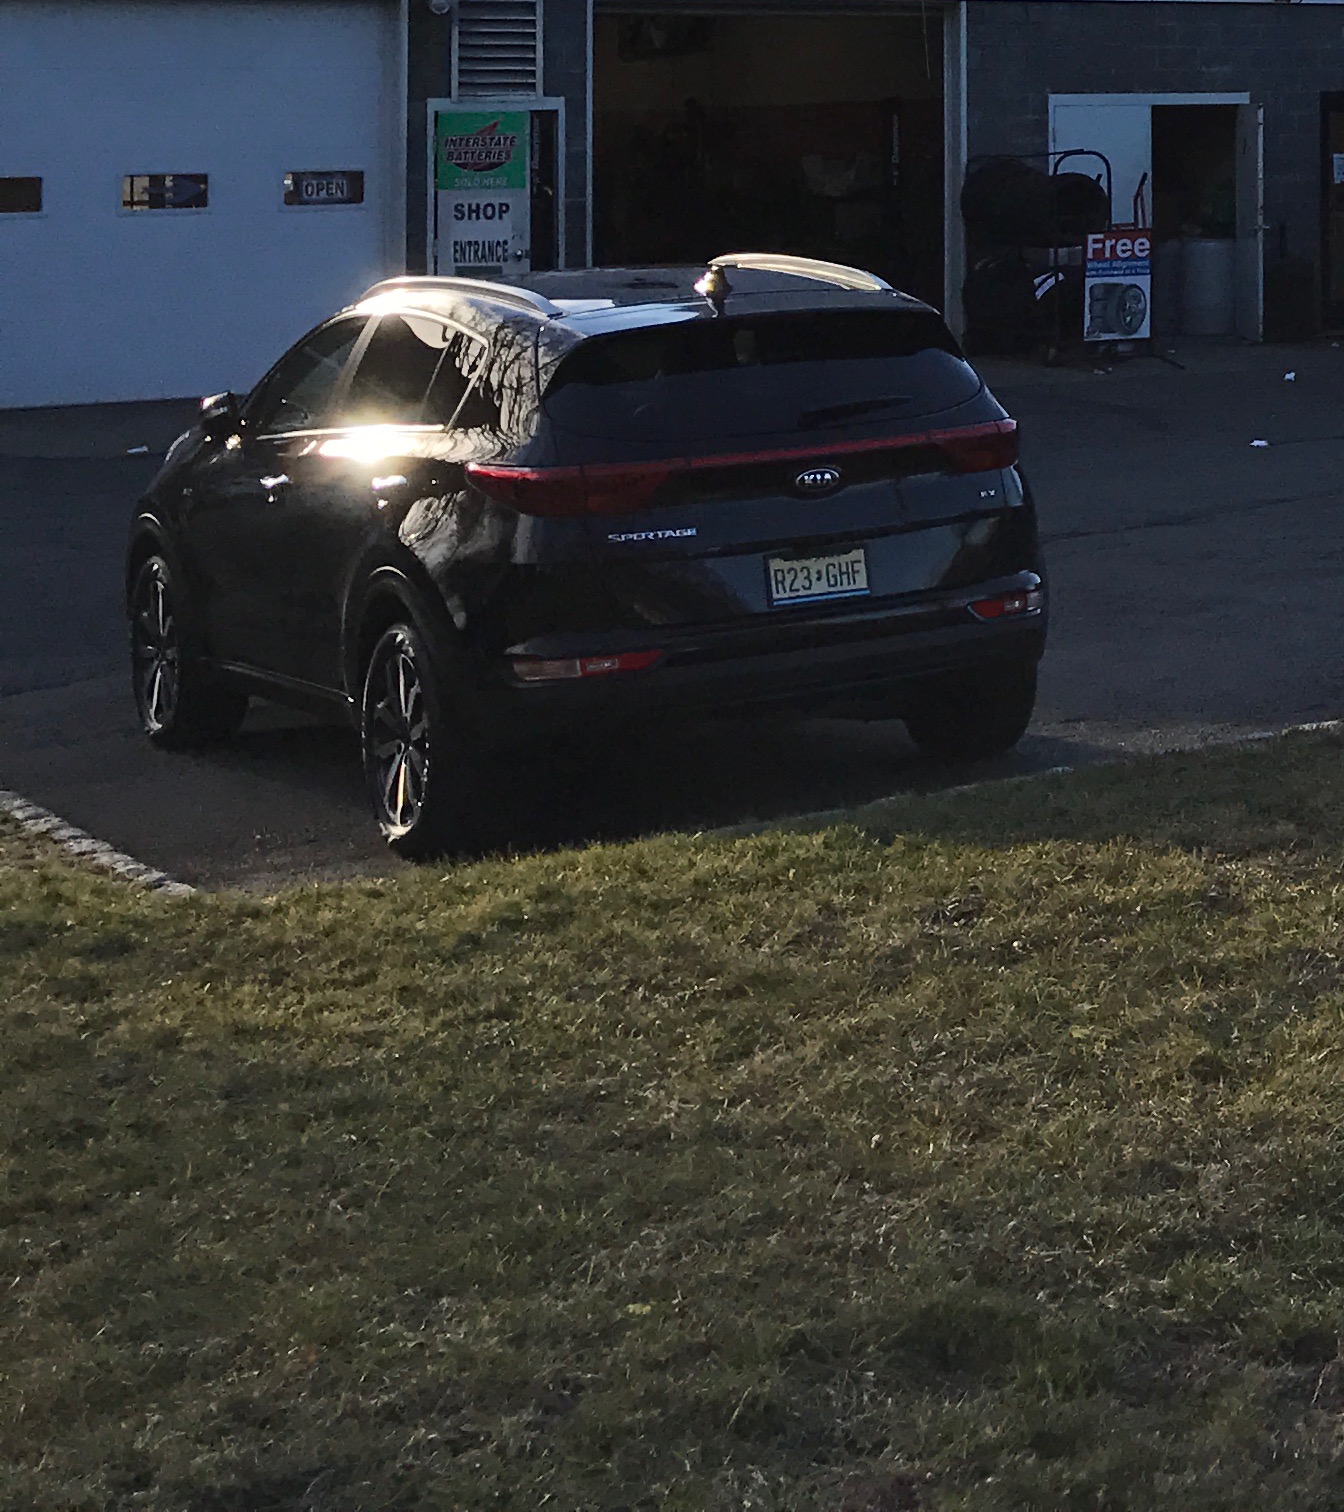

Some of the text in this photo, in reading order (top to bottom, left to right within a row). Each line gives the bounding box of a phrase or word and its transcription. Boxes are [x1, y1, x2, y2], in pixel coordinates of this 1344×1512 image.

[445, 136, 517, 148] INTERSTATE
[447, 150, 512, 162] BATTERIES
[304, 180, 345, 197] OPEN
[455, 177, 508, 187] SOLD HERE
[454, 203, 510, 220] SHOP
[453, 240, 508, 263] ENTRANCE
[1086, 234, 1150, 259] Free
[608, 527, 698, 543] SPORTAGE
